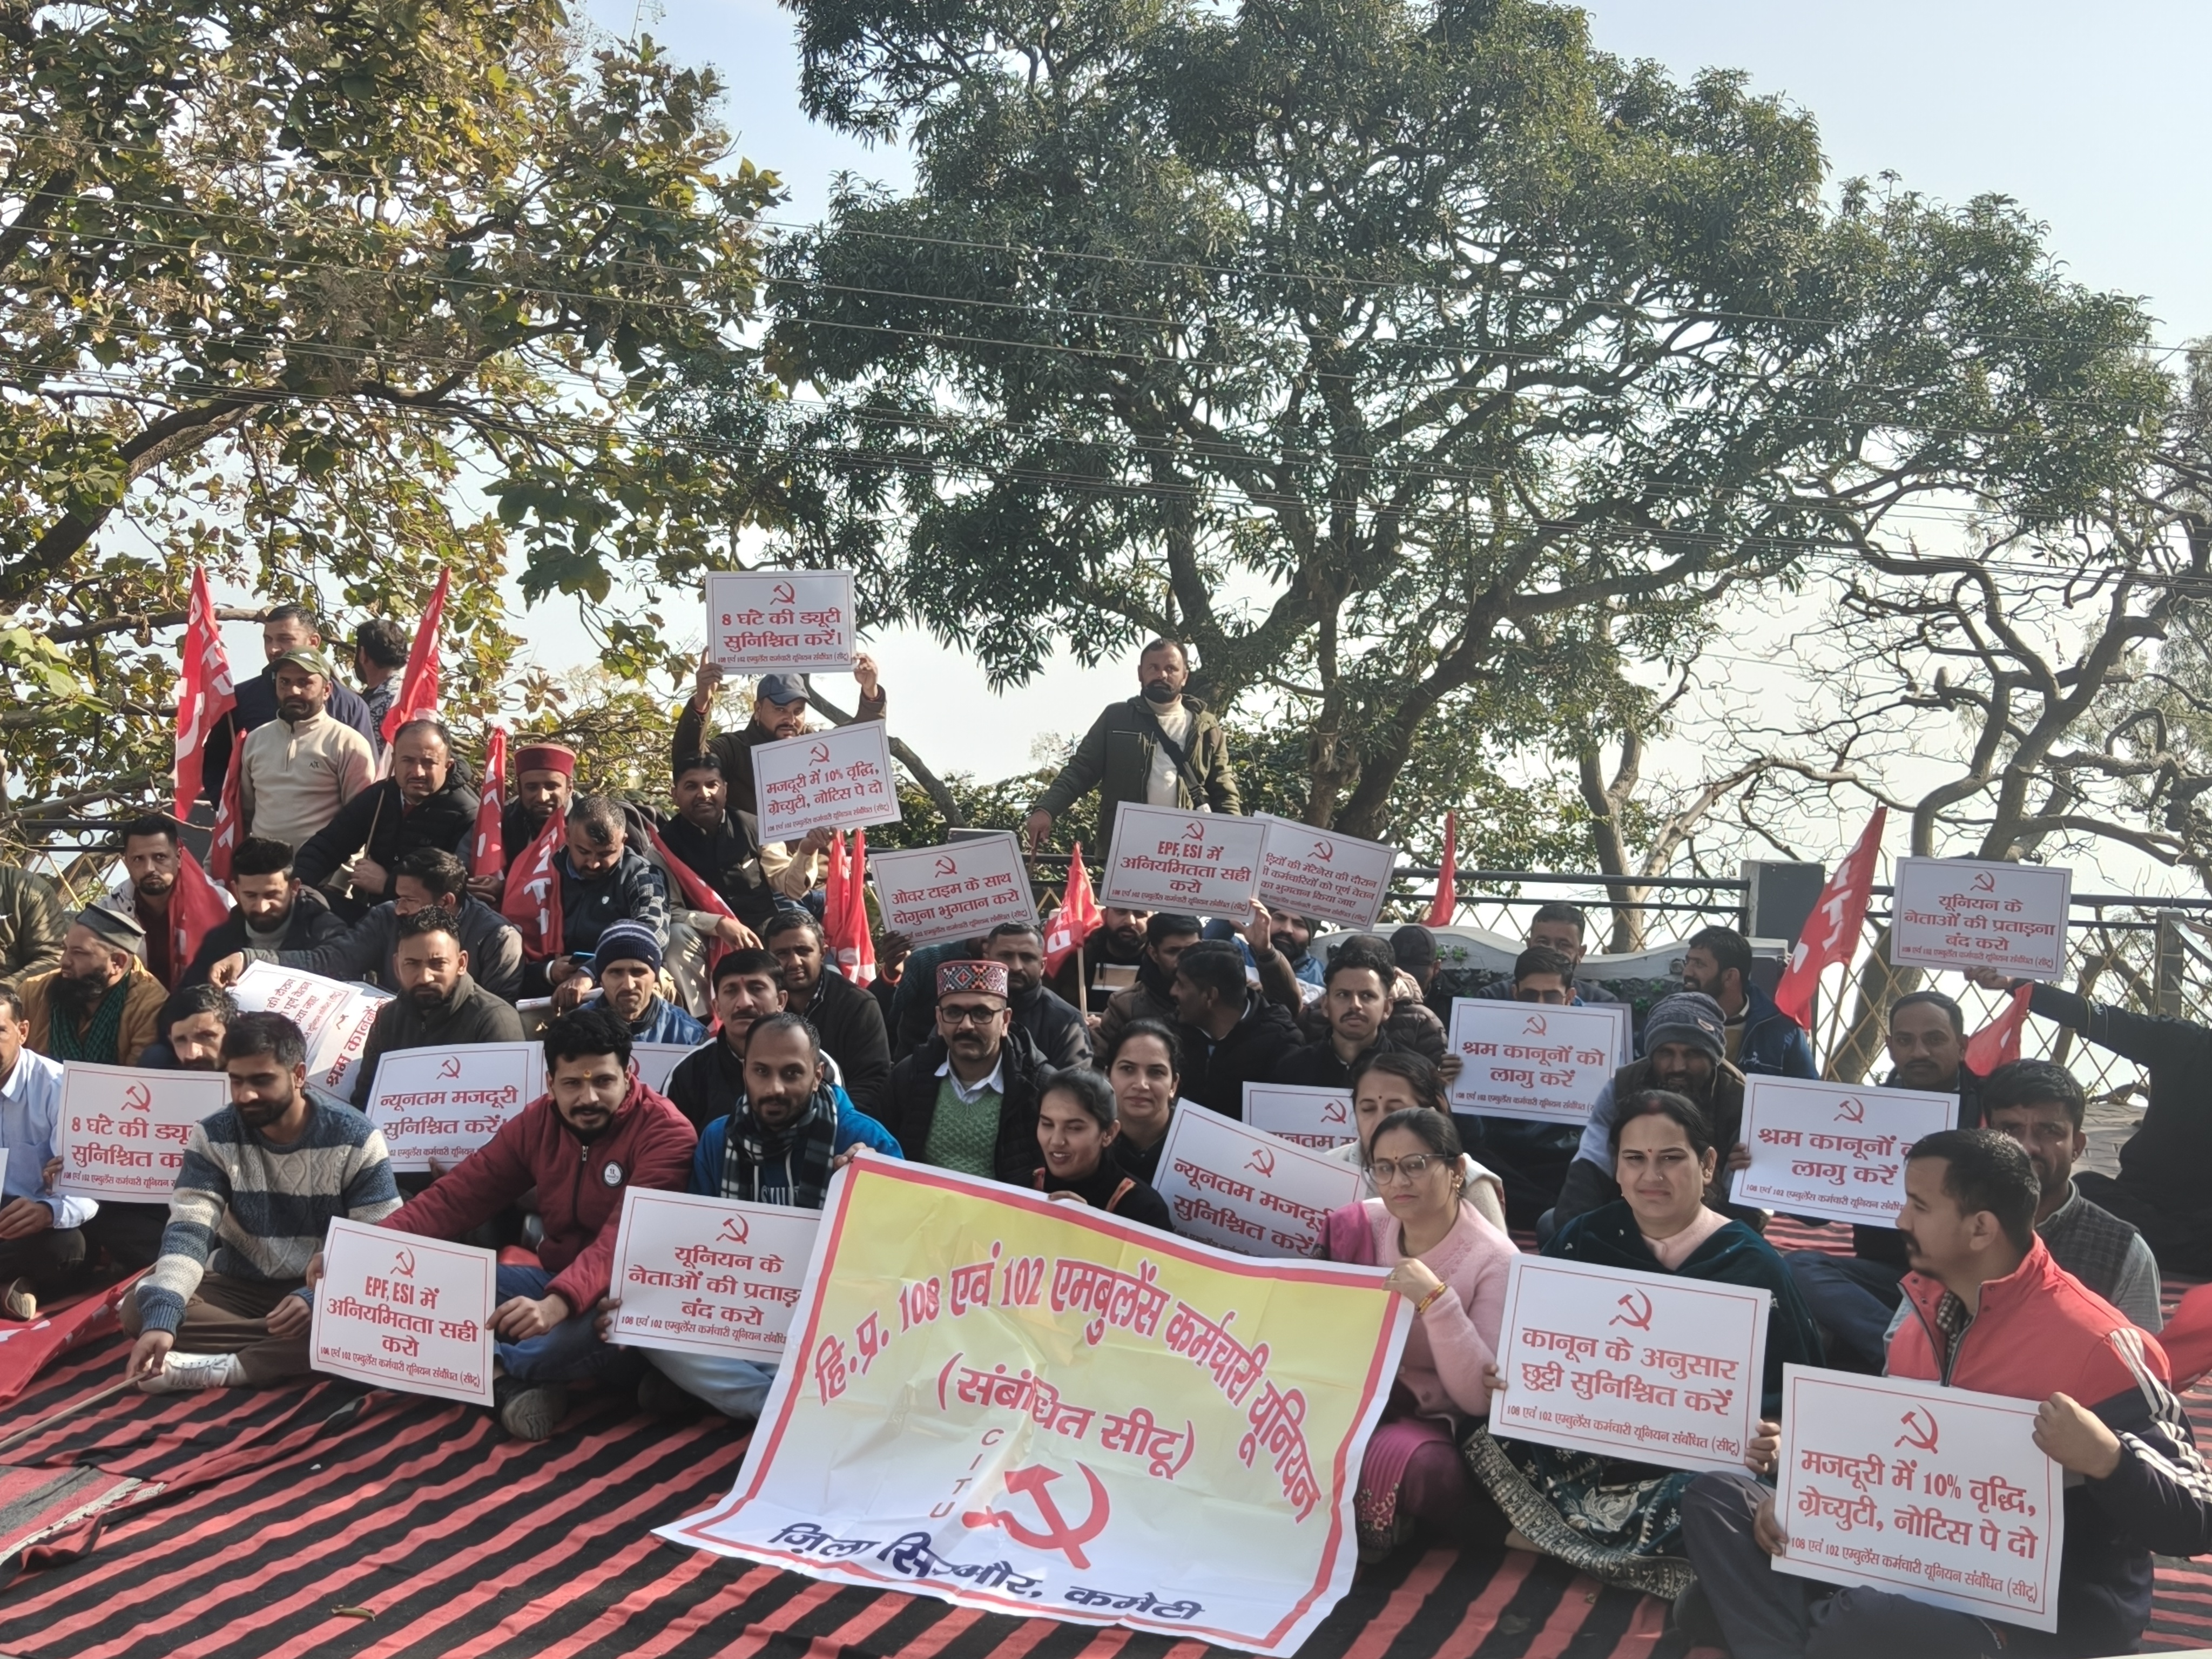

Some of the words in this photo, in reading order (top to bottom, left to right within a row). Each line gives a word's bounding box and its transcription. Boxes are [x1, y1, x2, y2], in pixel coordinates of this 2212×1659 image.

[721, 613, 731, 625] 8
[736, 609, 765, 625] घंटे
[768, 608, 794, 624] की
[799, 607, 841, 628] ड्यूटी
[723, 630, 799, 652] सुनिश्चित
[766, 773, 806, 793] मजदूरी
[809, 768, 820, 784] में
[825, 768, 843, 782] 10%
[846, 760, 879, 781] वृद्धि,
[767, 793, 810, 815] ग्रेच्युटी,
[813, 787, 851, 804] नोटिस
[854, 783, 864, 796] पे
[867, 779, 882, 793] दो
[1157, 841, 1179, 857] EPF,
[1182, 844, 1202, 858] ESI
[1206, 846, 1224, 861] में
[1120, 855, 1217, 878] अनियमितता
[1220, 866, 1251, 881] सही
[1265, 852, 1287, 866] ड़ियों
[1287, 860, 1301, 870] की
[1334, 871, 1348, 881] की
[891, 889, 926, 904] ओवर
[926, 882, 962, 898] टाइम
[963, 877, 979, 891] के
[982, 872, 1011, 887] साथ
[1170, 879, 1202, 893] करो
[1260, 880, 1274, 889] का
[1275, 884, 1310, 897] भुगतान
[1312, 890, 1336, 903] किया
[1271, 869, 1319, 887] कर्मचारियों
[1319, 881, 1333, 891] को
[1352, 887, 1375, 900] वेतन
[892, 907, 935, 926] दोगुना
[938, 896, 989, 919] भुगतान
[991, 888, 1019, 904] करो
[1938, 893, 2000, 912] यूनियन
[2004, 899, 2023, 912] के
[1904, 909, 1961, 927] नेताओं
[1963, 914, 1988, 929] की
[1992, 920, 2055, 937] प्रताड़ना
[1945, 932, 1972, 947] बंद
[1975, 936, 2009, 950] करो
[1462, 1041, 1498, 1056] श्रम
[1502, 1044, 1573, 1067] कानूनों
[1576, 1048, 1605, 1066] को
[326, 1053, 352, 1087] श्रम
[1490, 1067, 1534, 1088] लागु
[1539, 1069, 1575, 1087] करें
[380, 1091, 447, 1111] न्यूनतम
[451, 1085, 518, 1109] मजदूरी
[71, 1116, 80, 1132] 8
[86, 1113, 114, 1135] घंटे
[118, 1117, 149, 1138] की
[154, 1124, 193, 1145] ड्यू
[381, 1116, 460, 1142] सुनिश्चित
[1758, 1128, 1803, 1147] श्रम
[1809, 1133, 1897, 1160] कानूनों
[71, 1142, 153, 1168] सुनिश्चित
[1174, 1157, 1255, 1202] न्यूनतम
[1791, 1160, 1847, 1185] लागु
[1853, 1164, 1898, 1185] करें
[1174, 1194, 1264, 1240] सुनिश्चित
[1850, 1197, 1879, 1209] यूनियन
[675, 1244, 754, 1270] यूनियन
[759, 1254, 784, 1272] के
[365, 1276, 389, 1301] EPF,
[393, 1282, 414, 1304] ESI
[420, 1287, 439, 1309] में
[628, 1264, 703, 1290] नेताओं
[706, 1274, 738, 1294] की
[743, 1282, 801, 1307] प्रताड़
[326, 1296, 434, 1334] अनियमितता
[439, 1319, 478, 1341] सही
[682, 1297, 715, 1319] बंद
[720, 1305, 764, 1325] करो
[621, 1316, 633, 1325] 108
[636, 1315, 650, 1326] एवं
[650, 1319, 662, 1328] 102
[698, 1324, 730, 1337] कर्मचारी
[732, 1327, 761, 1341] यूनियन
[763, 1331, 787, 1345] संबंधि
[382, 1334, 419, 1357] करो
[1522, 1327, 1599, 1363] कानून
[1605, 1337, 1634, 1361] के
[1640, 1347, 1739, 1380] अनुसार
[342, 1351, 350, 1360] 102
[406, 1363, 430, 1376] यूनियन
[899, 1277, 940, 1333] 108
[950, 1242, 1001, 1316] एवं
[1001, 1257, 1045, 1306] 102
[1051, 1259, 1170, 1345] एमबुलेंस
[1166, 1301, 1269, 1406] कर्मचारी
[1239, 1380, 1321, 1524] यूनियन
[1521, 1360, 1564, 1391] छुट्टी
[1570, 1369, 1677, 1407] सुनिश्चित
[1684, 1388, 1733, 1415] करें
[938, 1352, 1096, 1440] (संबंधित
[1101, 1407, 1194, 1480] सीटू)
[1507, 1405, 1520, 1415] 108
[1522, 1405, 1537, 1419] एवं
[1539, 1411, 1552, 1421] 102
[1593, 1419, 1631, 1435] कर्मचारी
[1634, 1425, 1669, 1442] यूनियन
[1801, 1449, 1885, 1492] मजदूरी
[1891, 1459, 1917, 1491] में
[1924, 1472, 1961, 1499] 10%
[1969, 1475, 2035, 1516] वृद्धि,
[1798, 1485, 1883, 1532] ग्रेच्युटी,
[1894, 1504, 1973, 1546] नोटिस
[1979, 1518, 2001, 1551] पे
[2007, 1526, 2038, 1559] दो
[1791, 1537, 1805, 1549] 108
[1808, 1537, 1824, 1553] एवं
[1825, 1544, 1839, 1556] 102
[1882, 1554, 1922, 1574] कर्मचारी
[1924, 1562, 1962, 1582] यूनियन
[1064, 1585, 1206, 1620] कमेटी
